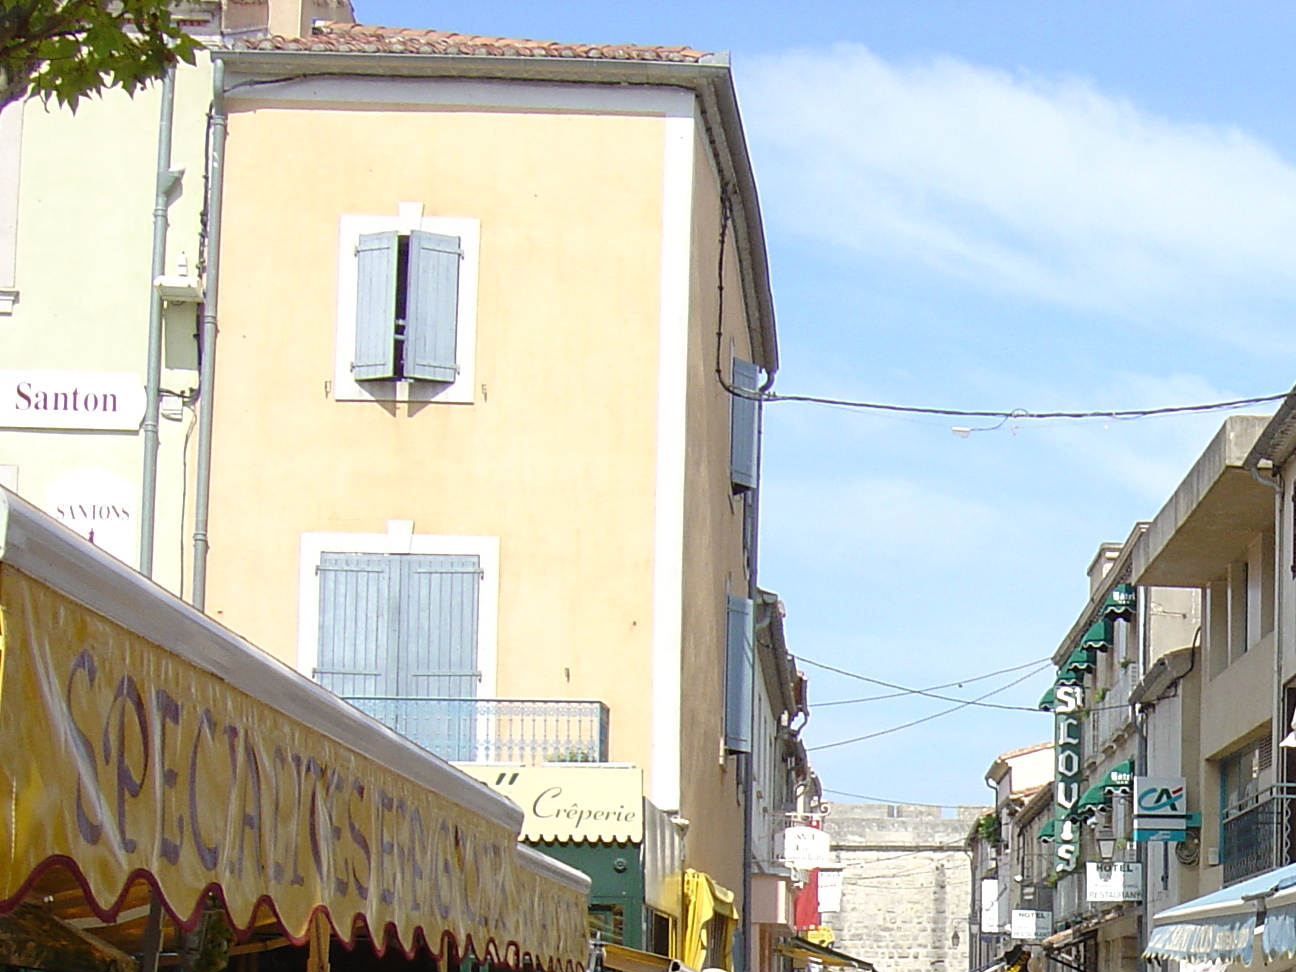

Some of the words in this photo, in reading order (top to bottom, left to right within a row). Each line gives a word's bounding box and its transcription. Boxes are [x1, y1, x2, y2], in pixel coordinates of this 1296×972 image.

[15, 381, 117, 413] Santon
[56, 504, 130, 521] SANTONS
[532, 786, 636, 829] Crêperie
[1096, 863, 1134, 873] HOTEL
